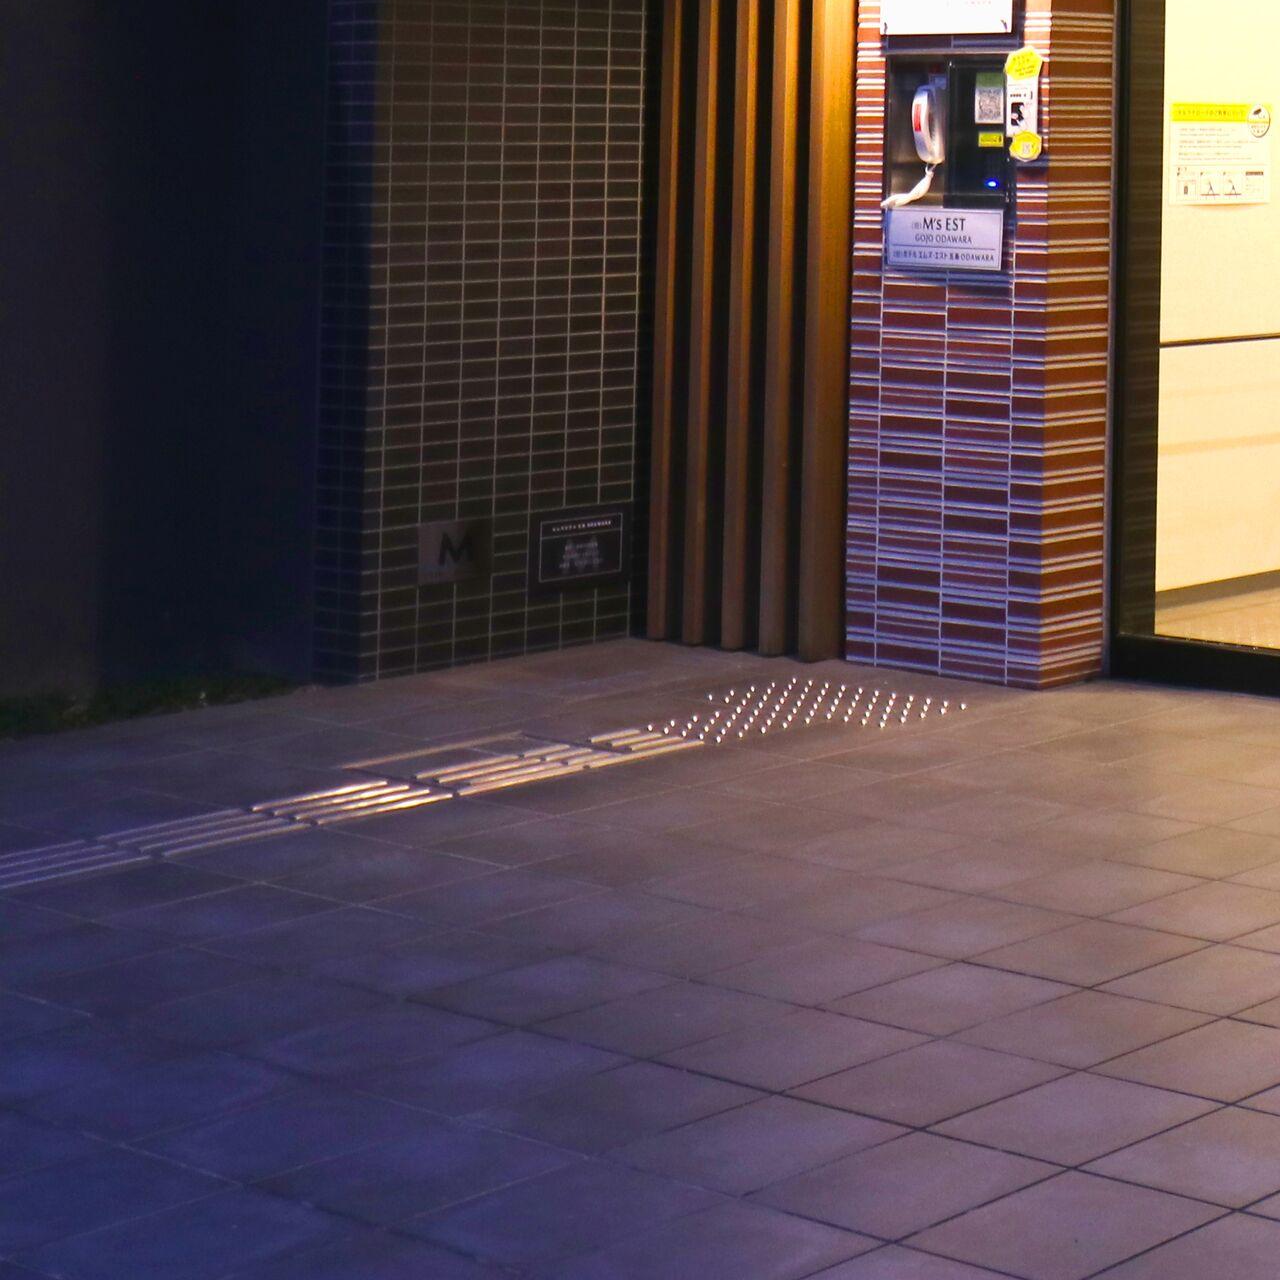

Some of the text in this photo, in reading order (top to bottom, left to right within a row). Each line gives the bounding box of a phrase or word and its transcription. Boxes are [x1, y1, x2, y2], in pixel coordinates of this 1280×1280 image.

[923, 218, 942, 231] M's
[946, 218, 966, 231] EST
[915, 233, 972, 244] GOJO ODAWARA
